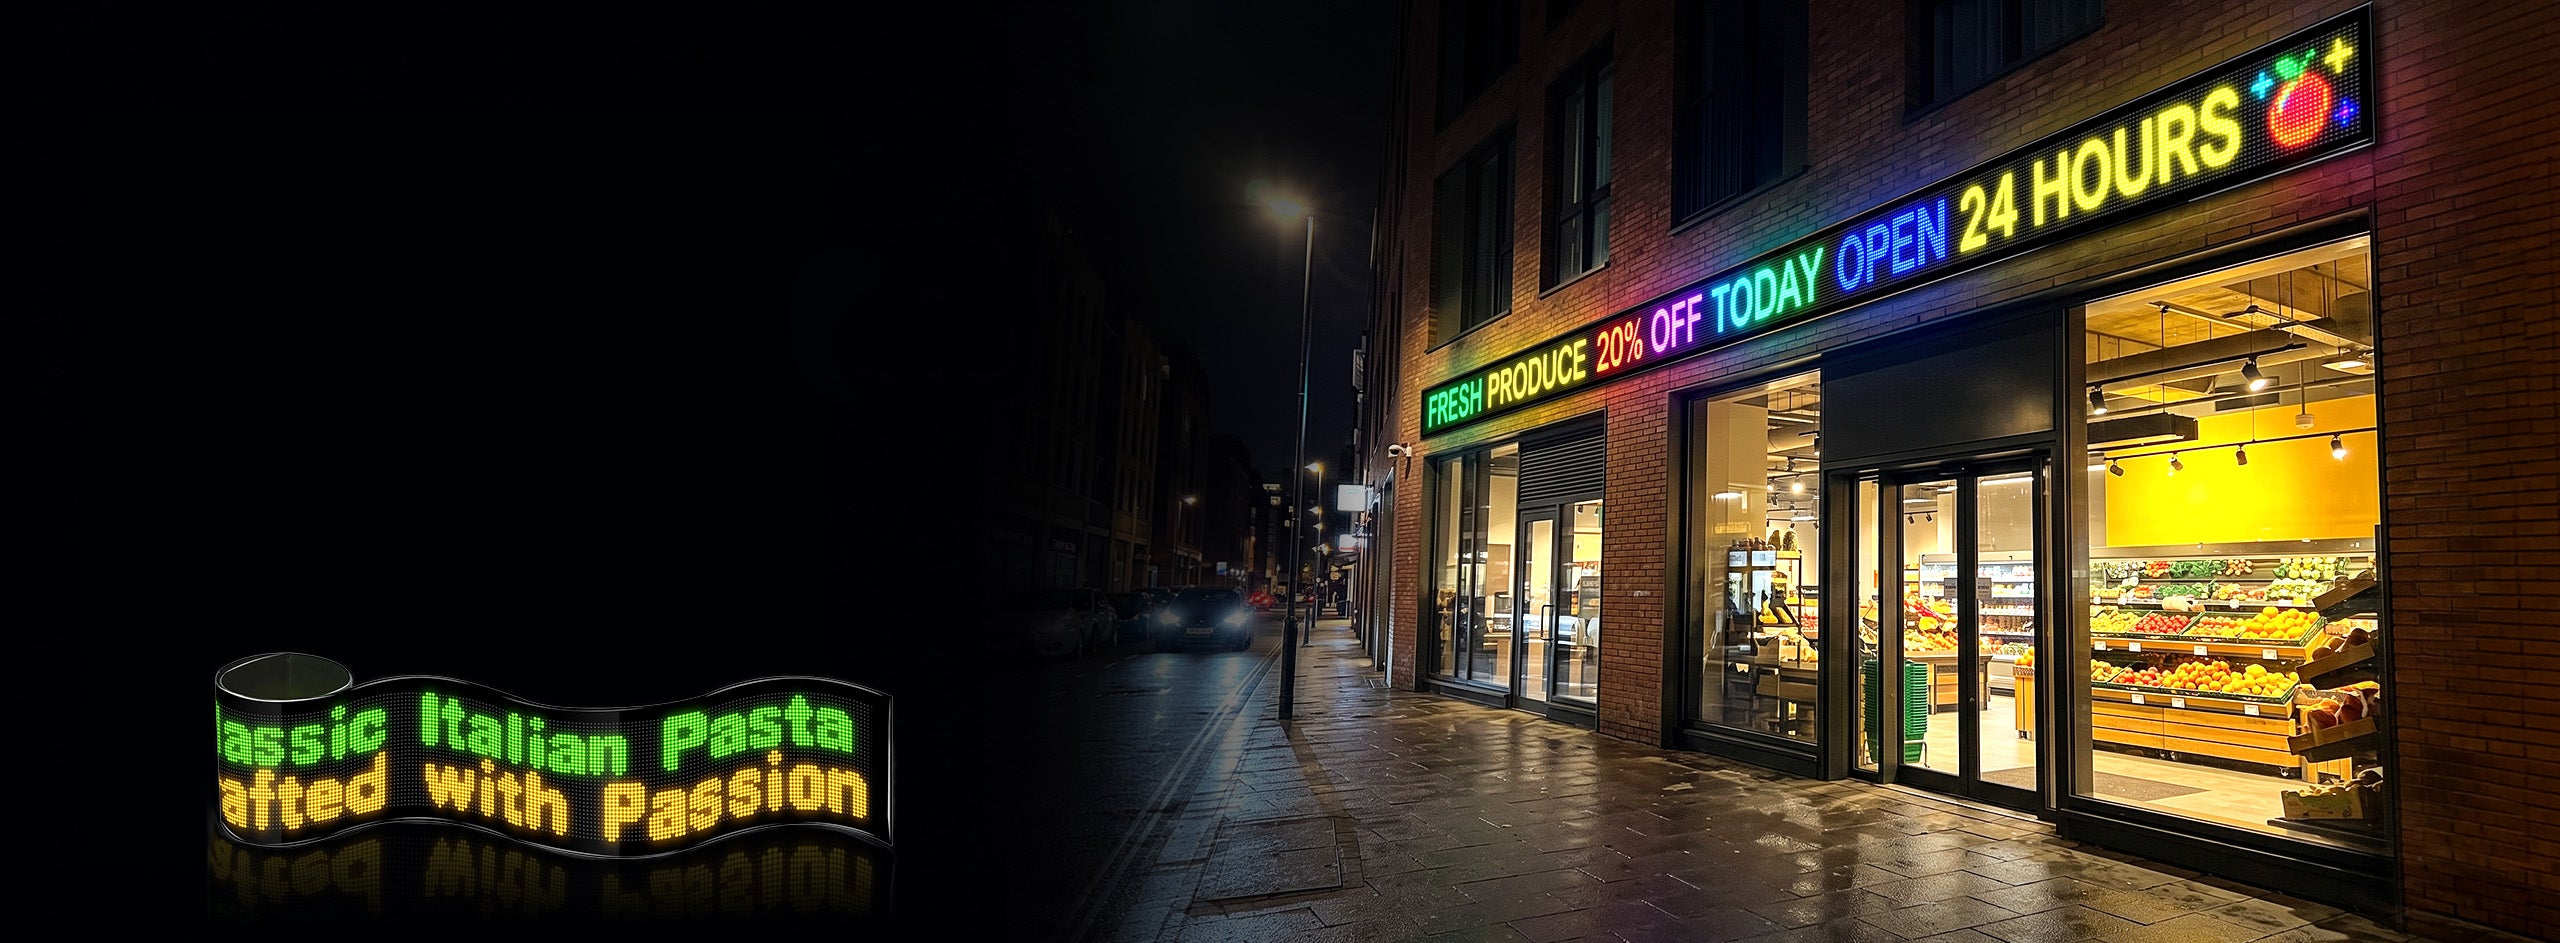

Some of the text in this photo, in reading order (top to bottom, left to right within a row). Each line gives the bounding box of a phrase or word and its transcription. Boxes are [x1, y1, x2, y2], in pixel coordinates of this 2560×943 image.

[1427, 85, 2242, 428] FRESH PRODUCE 20% OFF TODAY OPEN 24 HOURS
[420, 691, 629, 776] Italian
[660, 694, 855, 772] Pasta
[423, 758, 568, 838] with
[602, 748, 868, 842] Passion
